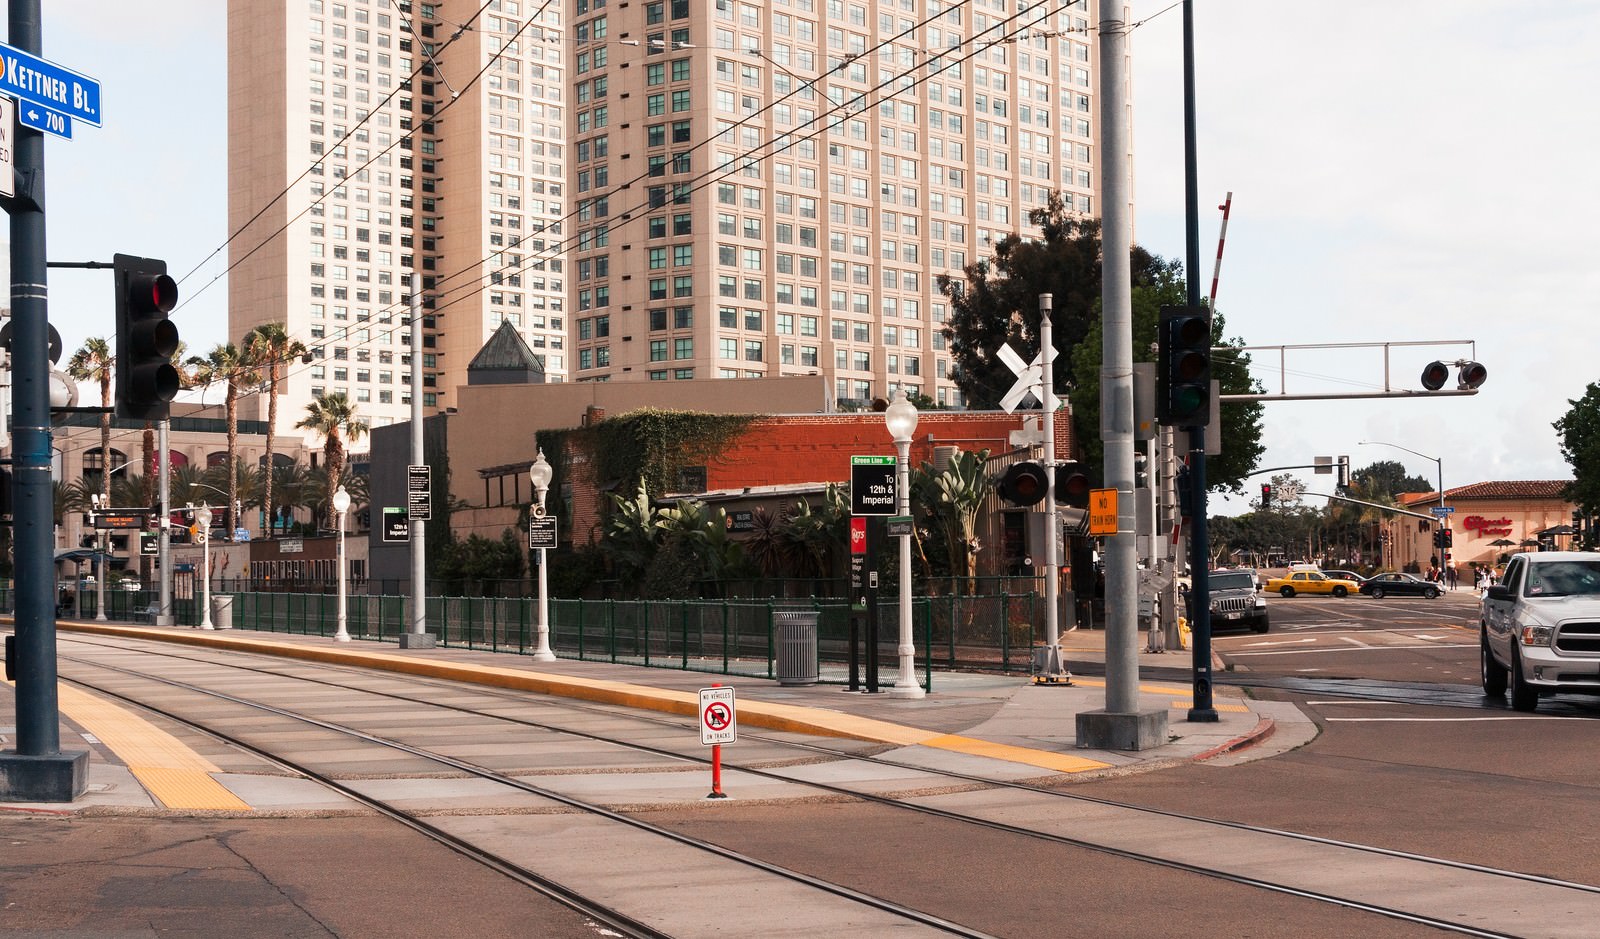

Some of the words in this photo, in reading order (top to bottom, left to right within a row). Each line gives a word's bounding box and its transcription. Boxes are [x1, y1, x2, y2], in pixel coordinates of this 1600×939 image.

[7, 56, 68, 104] KETTNER
[73, 82, 95, 115] BL.
[46, 111, 65, 133] 700
[884, 474, 894, 484] To
[869, 485, 886, 494] 12th
[887, 485, 894, 494] &
[862, 495, 894, 506] Imperial
[1099, 497, 1108, 509] NO
[1091, 515, 1104, 526] TRAIN
[1104, 514, 1116, 526] HORN
[711, 692, 731, 700] VEHICLES
